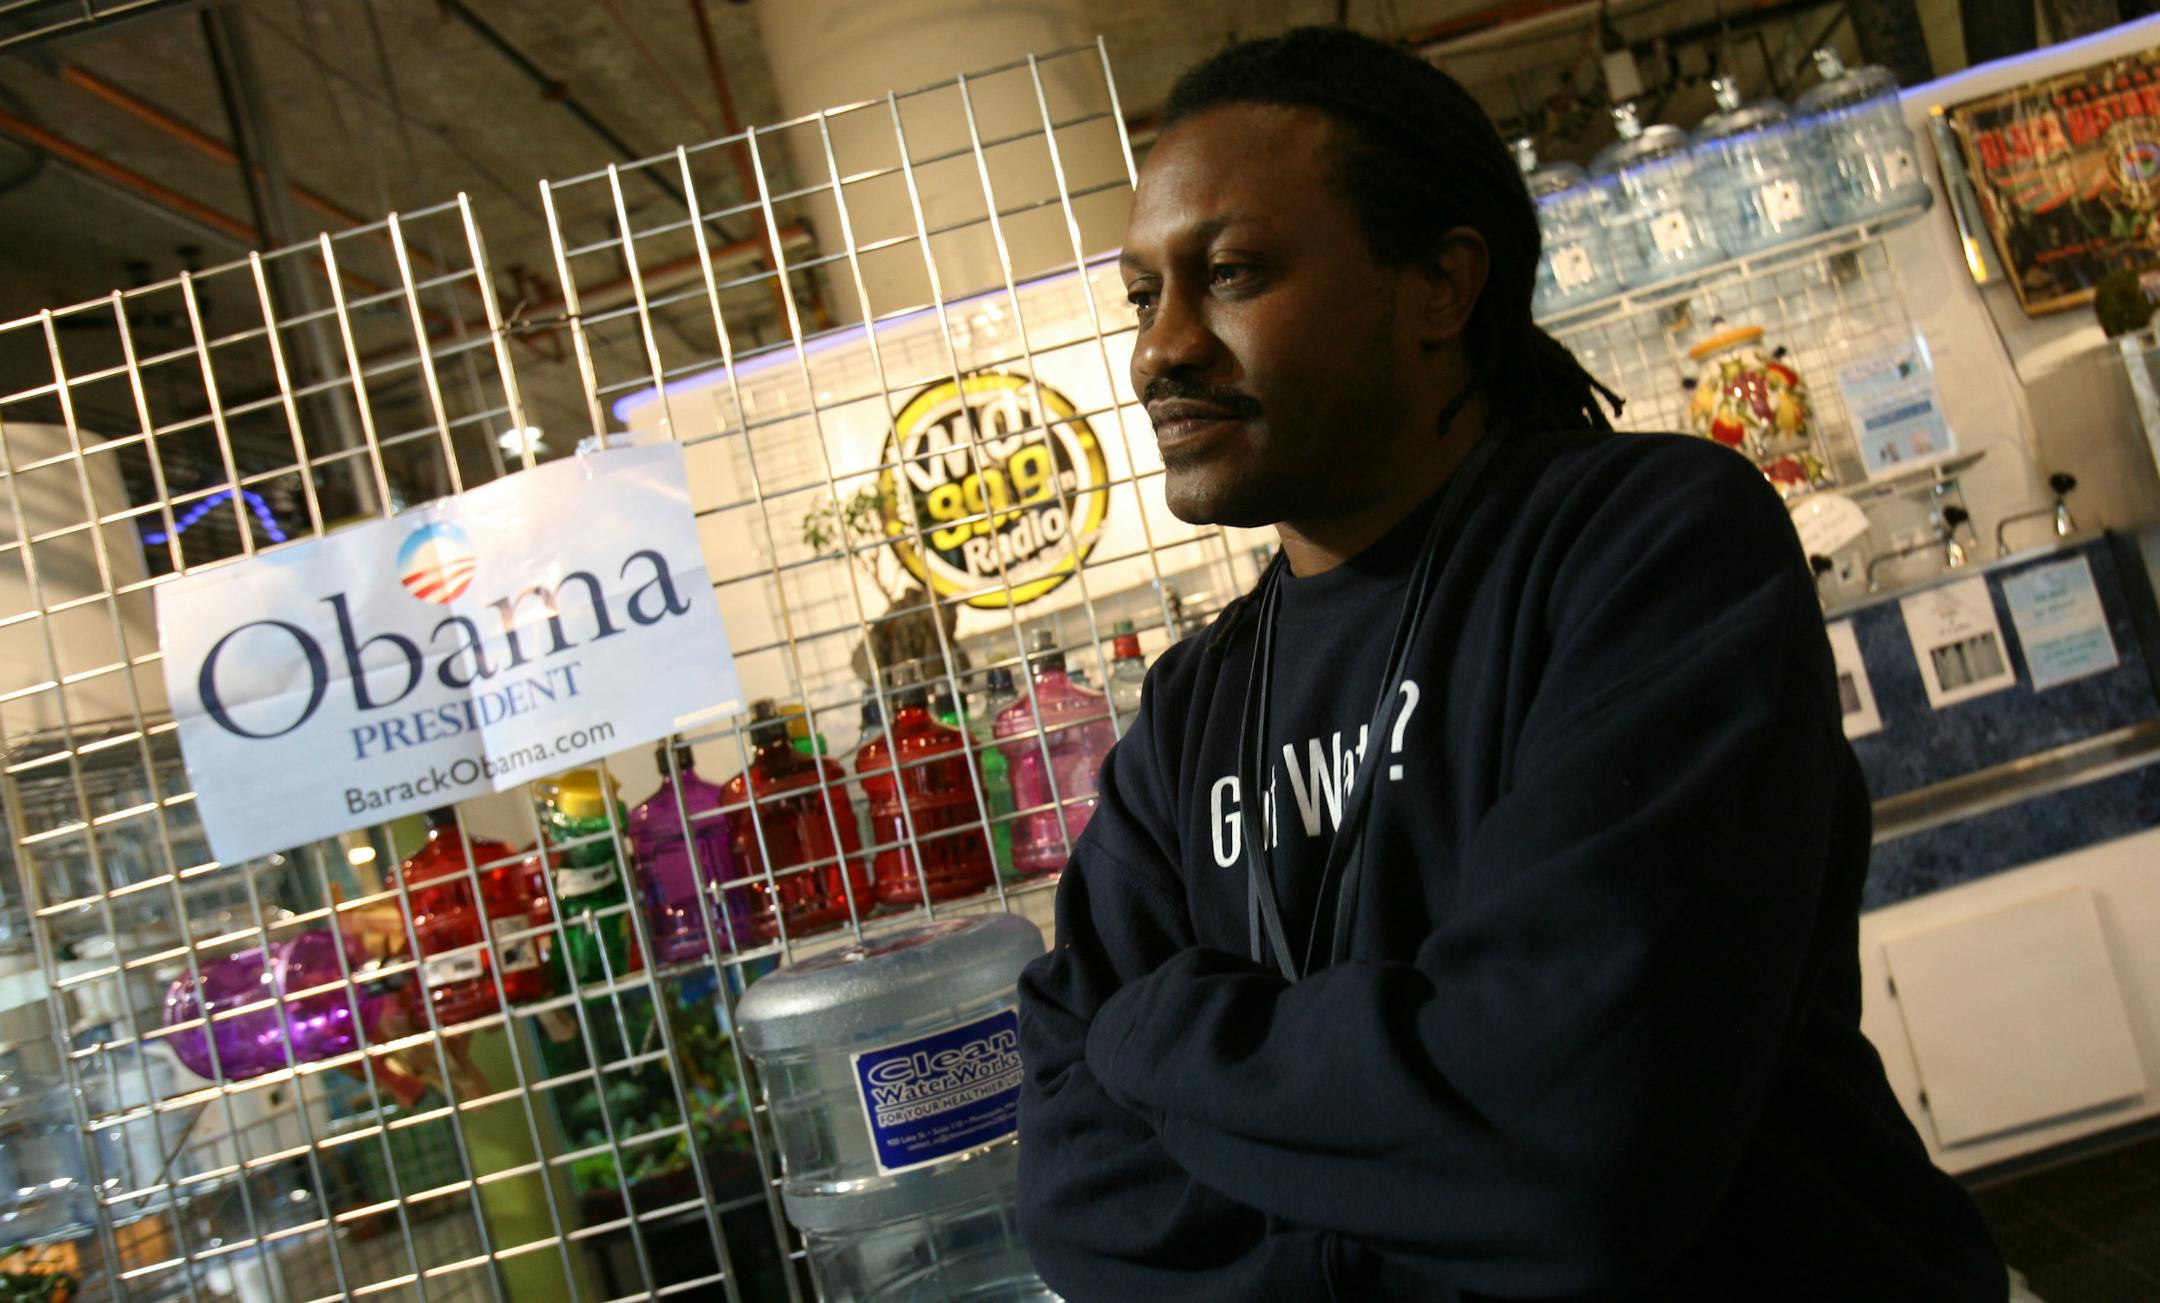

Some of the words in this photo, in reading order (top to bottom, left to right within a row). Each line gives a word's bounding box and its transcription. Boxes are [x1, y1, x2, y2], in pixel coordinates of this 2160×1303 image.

[963, 508, 1066, 577] Radio
[197, 549, 693, 741] Obama
[352, 662, 583, 760] PRESIDENT
[344, 718, 615, 815] BarackObama.com
[1211, 765, 1278, 868] Gt
[868, 1029, 1017, 1086] Clean
[874, 1052, 1019, 1105] WaterWorks
[880, 1112, 904, 1124] FOR
[906, 1103, 940, 1119] YOUR
[943, 1081, 1004, 1111] HEALTHIER
